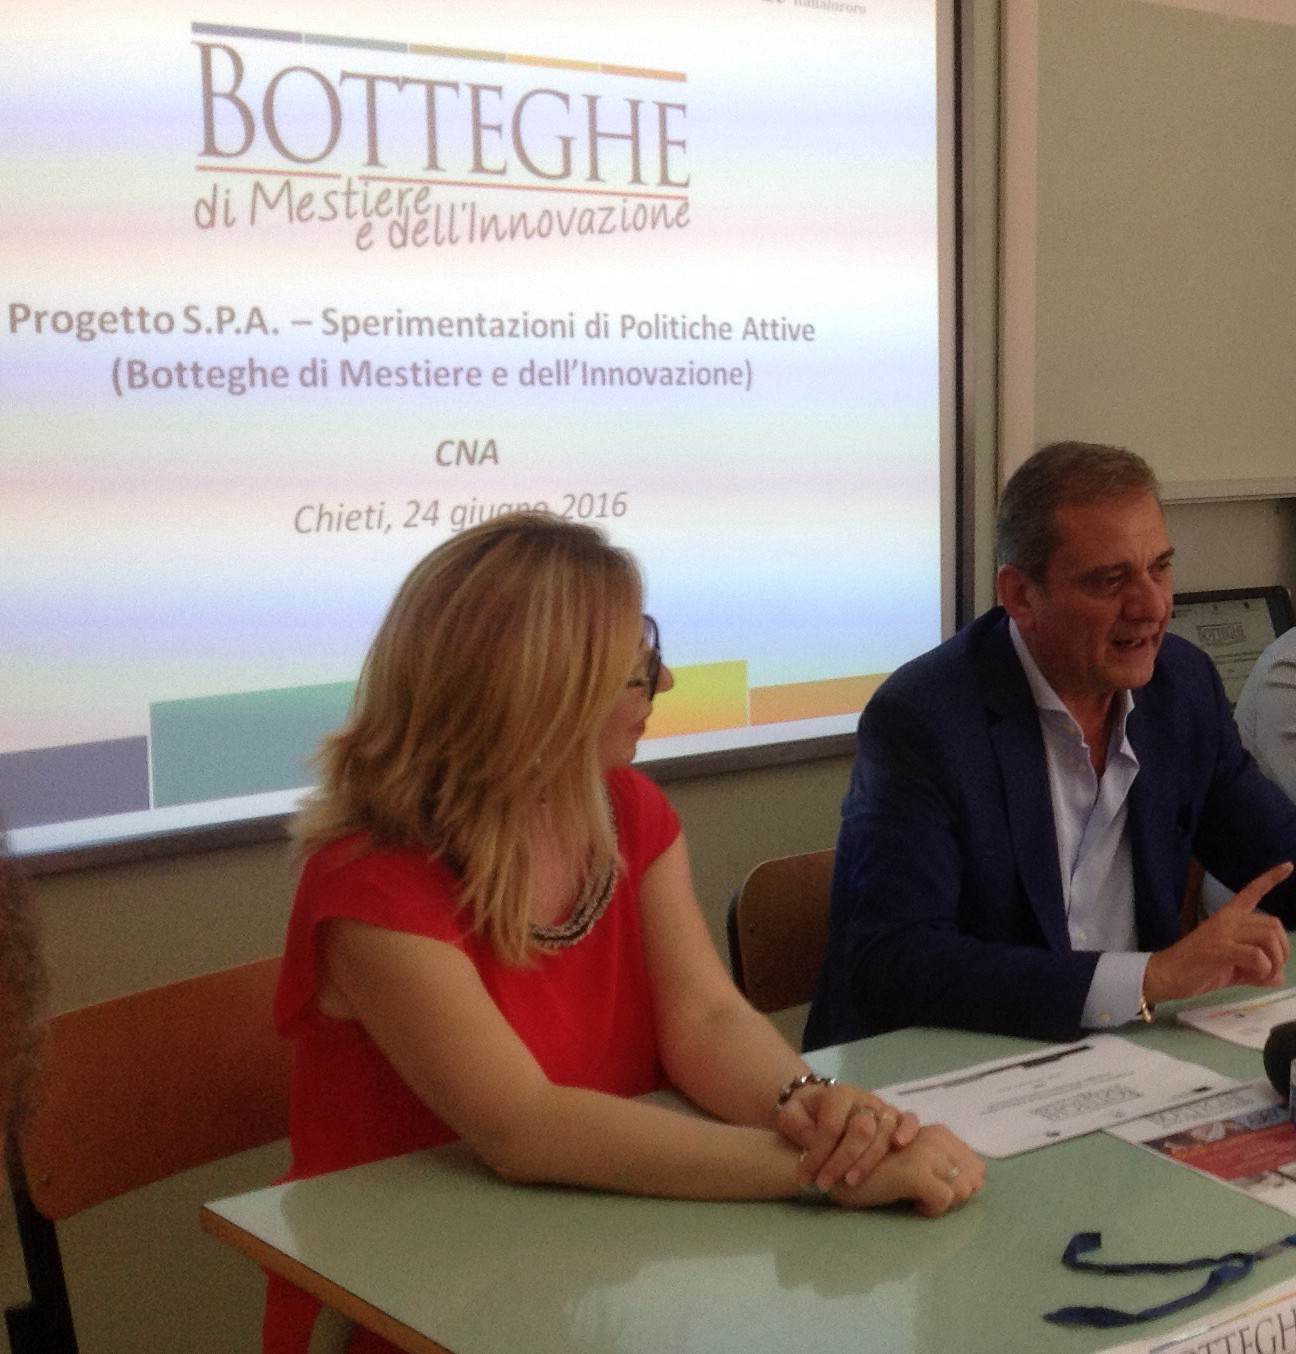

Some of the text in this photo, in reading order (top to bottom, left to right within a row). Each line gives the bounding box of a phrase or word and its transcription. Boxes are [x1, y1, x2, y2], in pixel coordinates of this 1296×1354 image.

[193, 42, 690, 187] BOTTEGHE
[194, 175, 431, 229] di Mestiere
[355, 199, 691, 251] e dell'Innovazione
[8, 303, 175, 342] Progetto
[183, 306, 279, 336] S.P.A.
[321, 307, 576, 343] Sperimentazioni
[584, 312, 611, 339] di
[619, 313, 733, 342] Politiche
[741, 315, 816, 343] Attive
[111, 357, 289, 398] (Botteghe
[298, 358, 329, 388] di
[339, 358, 484, 389] Mestiere
[491, 366, 509, 388] e
[435, 438, 500, 469] CNA
[294, 500, 392, 534] Chieti,
[403, 499, 440, 528] 24
[560, 490, 628, 520] 2016
